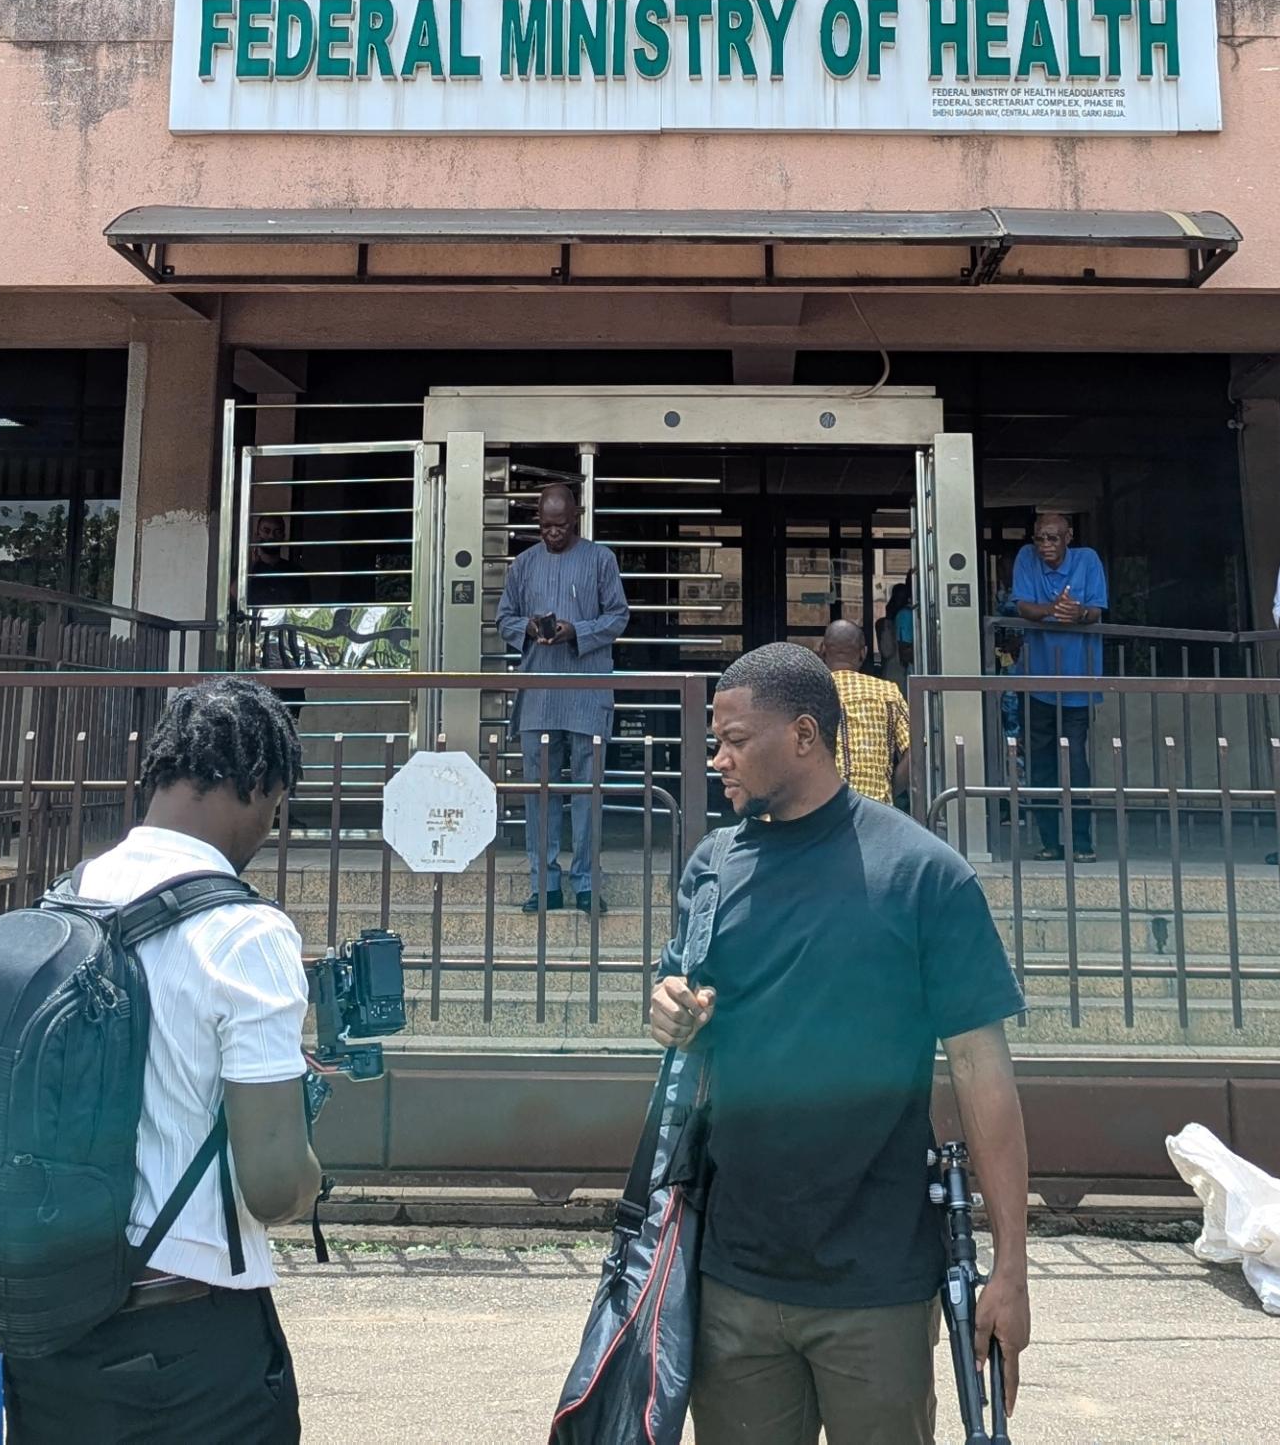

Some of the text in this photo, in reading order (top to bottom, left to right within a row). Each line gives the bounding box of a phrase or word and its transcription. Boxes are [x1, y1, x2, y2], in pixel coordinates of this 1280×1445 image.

[932, 88, 1125, 97] FEDERAL MINISTRY OF HEALTH HEADQUARTERS
[1037, 99, 1082, 108] COMPLEX,
[1084, 99, 1113, 107] PHASE
[1001, 109, 1029, 117] CENTRAL
